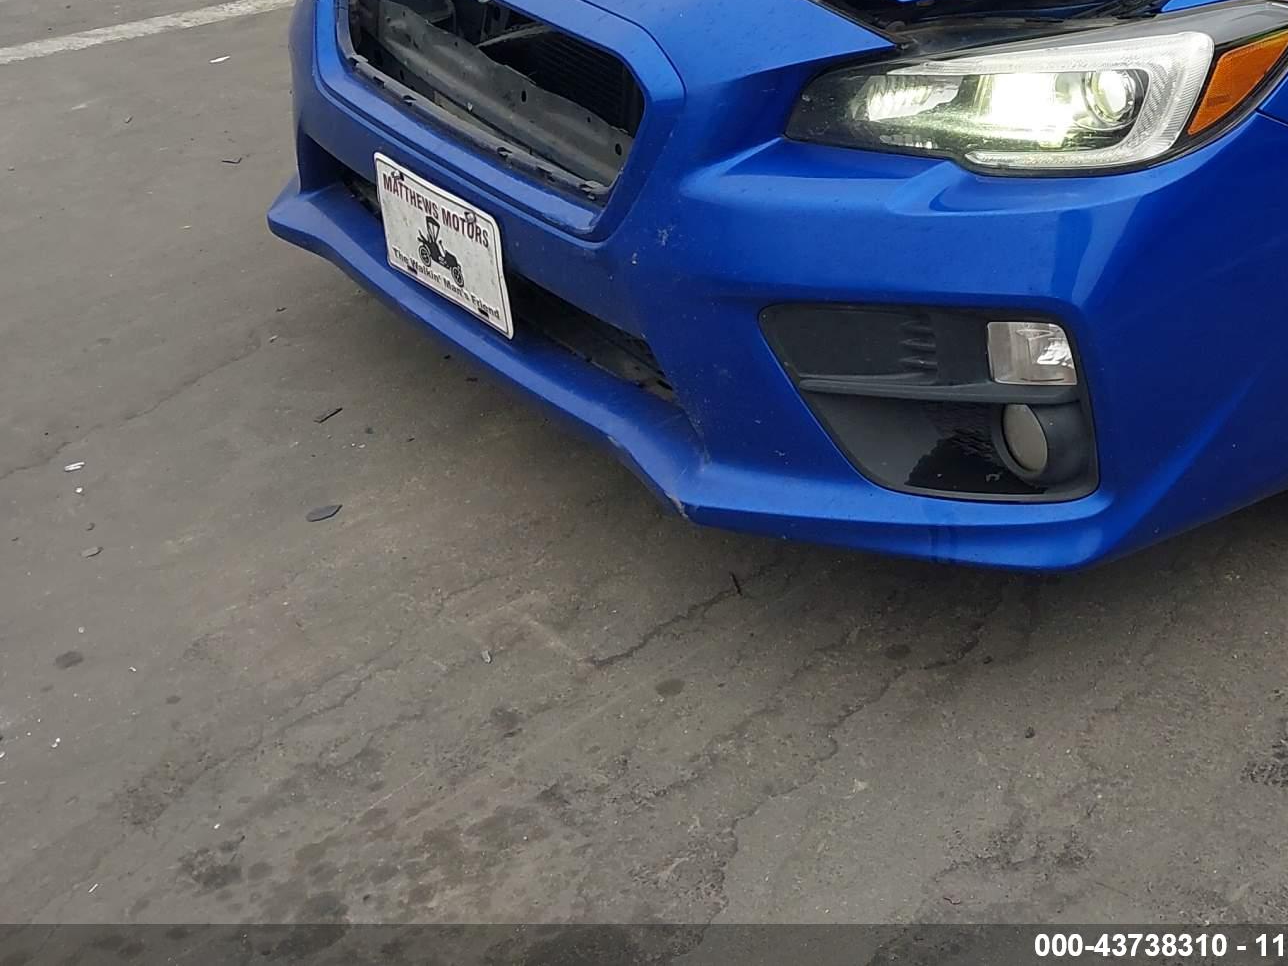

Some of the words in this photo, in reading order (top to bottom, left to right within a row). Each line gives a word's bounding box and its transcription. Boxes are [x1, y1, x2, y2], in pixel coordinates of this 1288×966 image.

[382, 172, 439, 220] MATTHEWS
[441, 207, 490, 249] MOTORS
[392, 248, 409, 264] The
[443, 278, 470, 302] Man's
[470, 294, 501, 320] Friend
